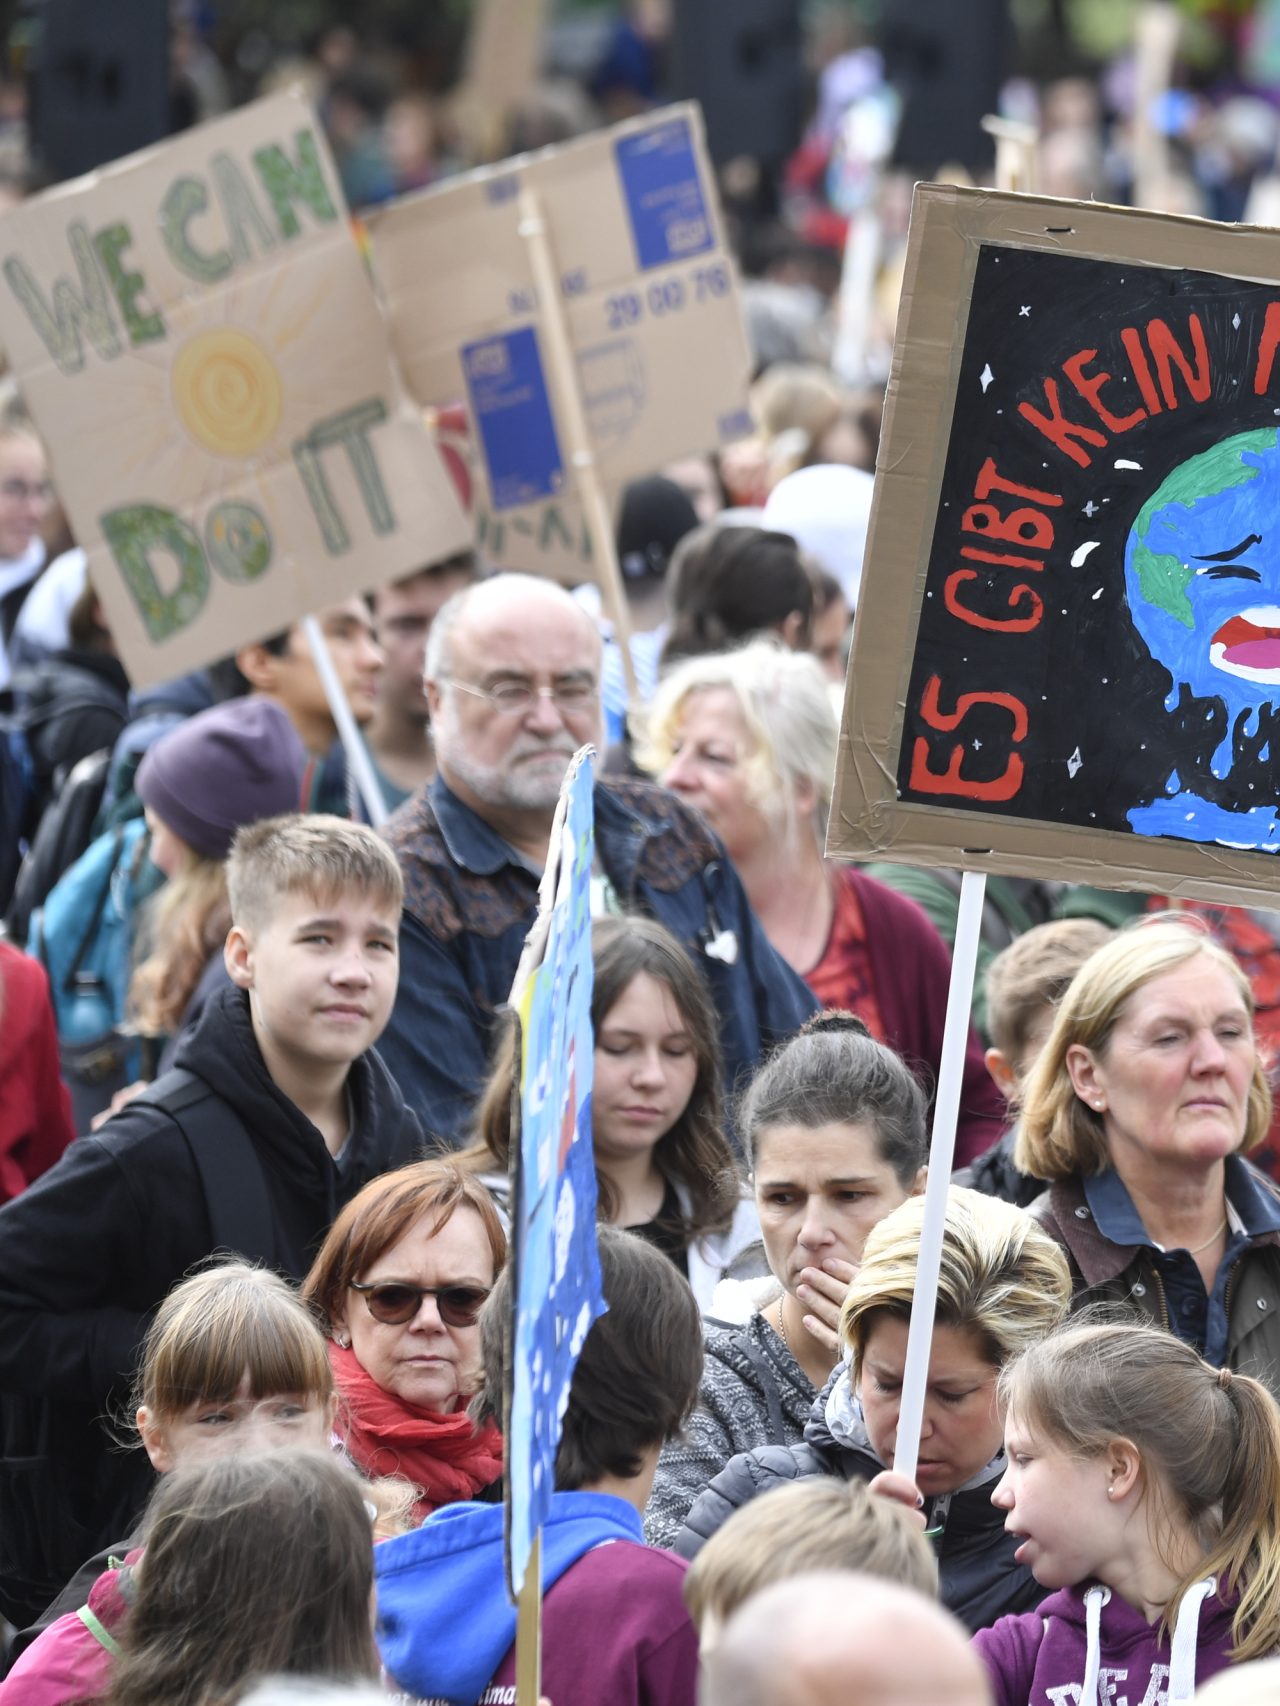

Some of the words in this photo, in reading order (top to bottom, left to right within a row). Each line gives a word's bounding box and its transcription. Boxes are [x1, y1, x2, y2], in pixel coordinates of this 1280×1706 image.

[2, 215, 168, 376] WE
[158, 128, 340, 285] CAN
[1018, 315, 1210, 467] KEIN
[292, 394, 396, 557] IT
[945, 459, 1063, 632] GIBT
[910, 677, 1028, 800] ES
